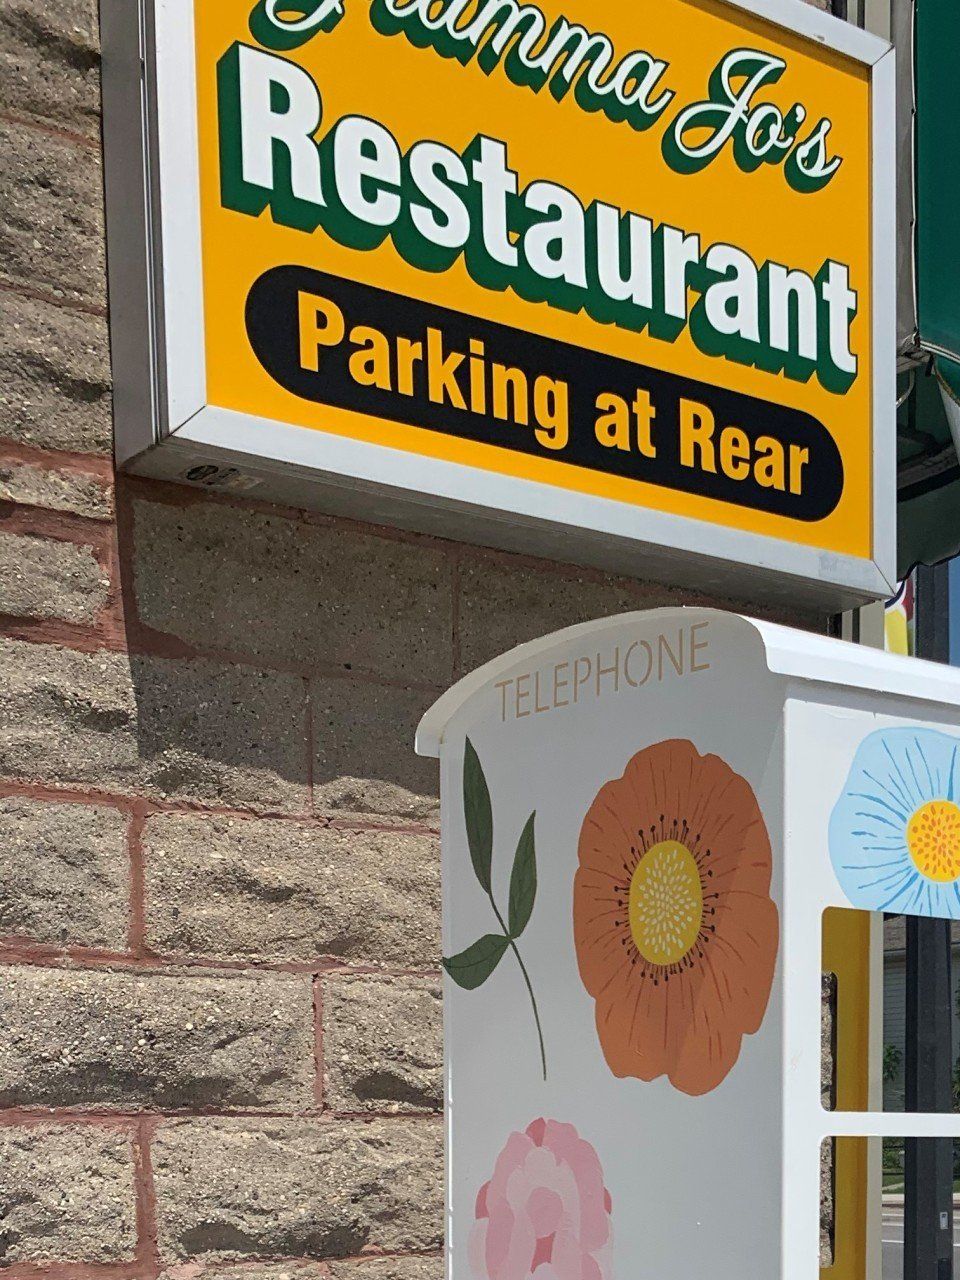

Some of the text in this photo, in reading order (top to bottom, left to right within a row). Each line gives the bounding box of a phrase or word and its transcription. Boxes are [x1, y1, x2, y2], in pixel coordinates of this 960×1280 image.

[675, 49, 840, 176] Jo's
[236, 46, 859, 374] Restaurant
[297, 290, 810, 496] Parking at Rear
[495, 621, 711, 722] TELEPHONE
